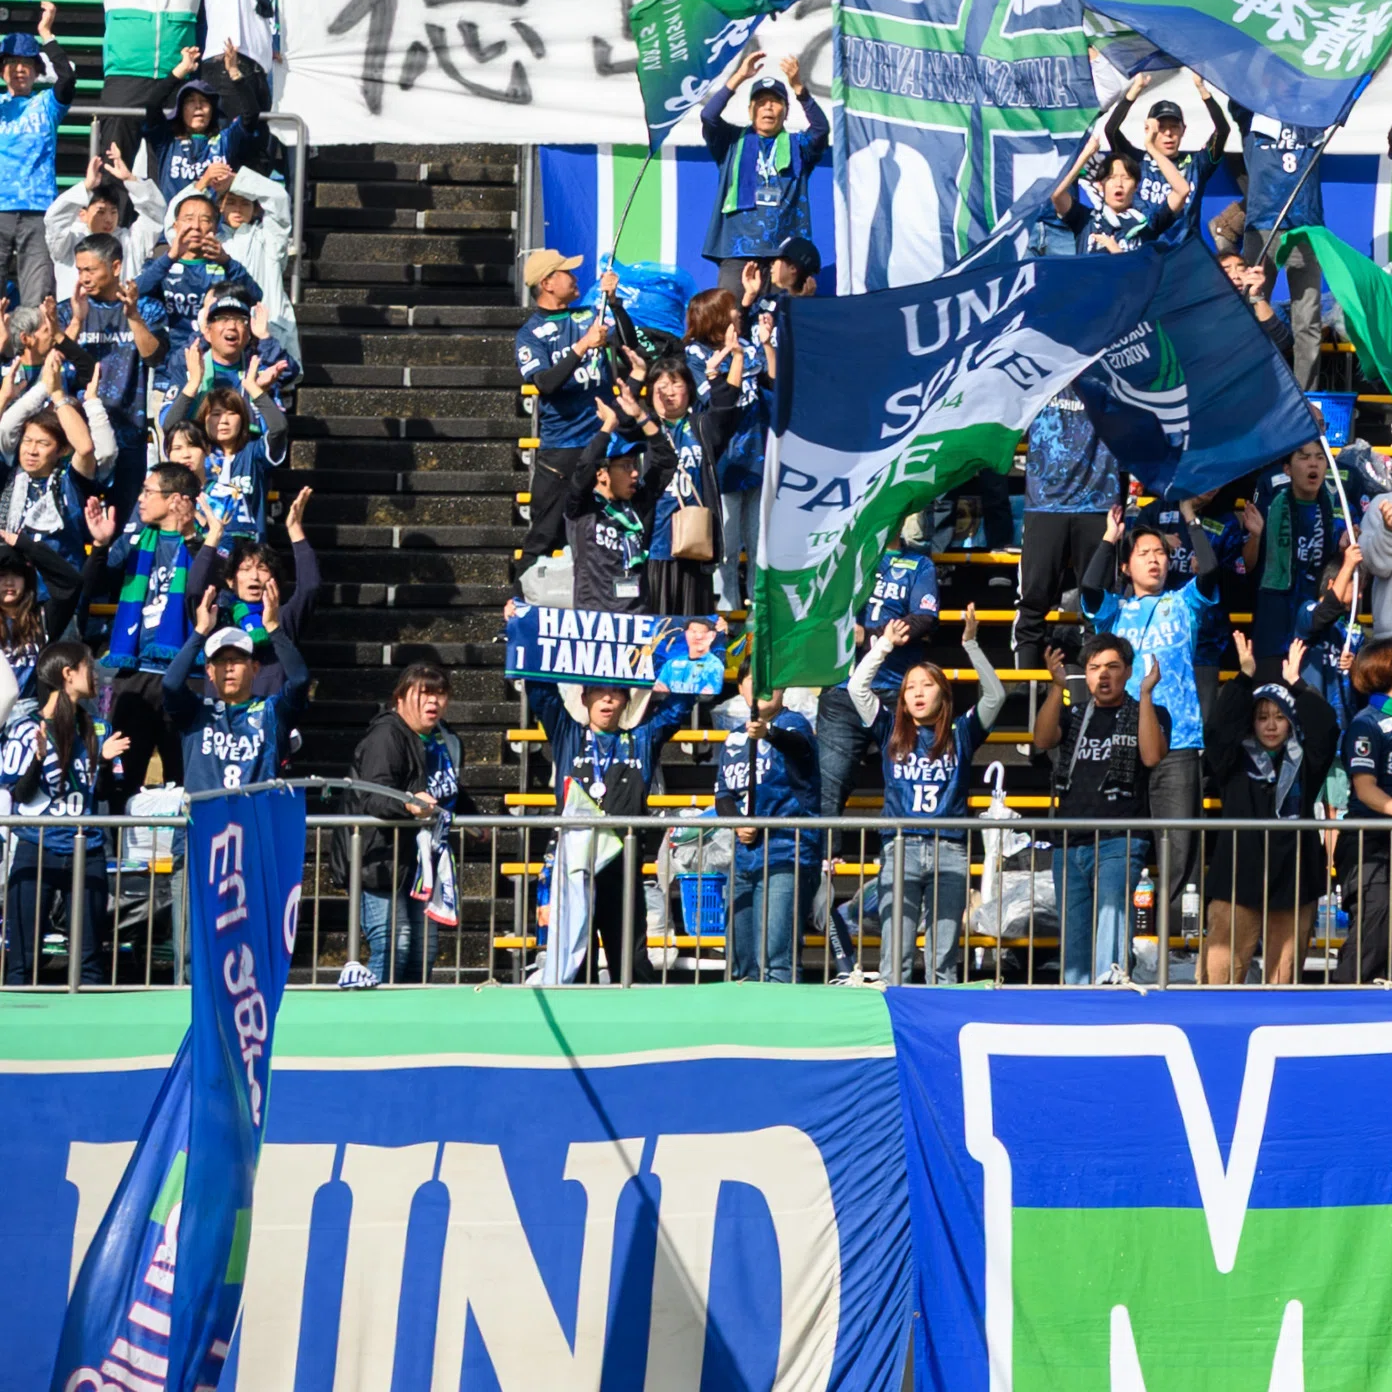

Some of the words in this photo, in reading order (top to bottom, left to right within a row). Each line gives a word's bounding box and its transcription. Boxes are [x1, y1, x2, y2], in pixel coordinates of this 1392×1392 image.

[1281, 152, 1298, 175] 8
[900, 263, 1037, 358] UNA
[537, 607, 655, 644] HAYATE
[515, 645, 526, 670] 1
[537, 638, 657, 681] TANAKA
[223, 764, 243, 790] 8
[892, 763, 955, 782] SWEAT
[911, 784, 939, 812] 13
